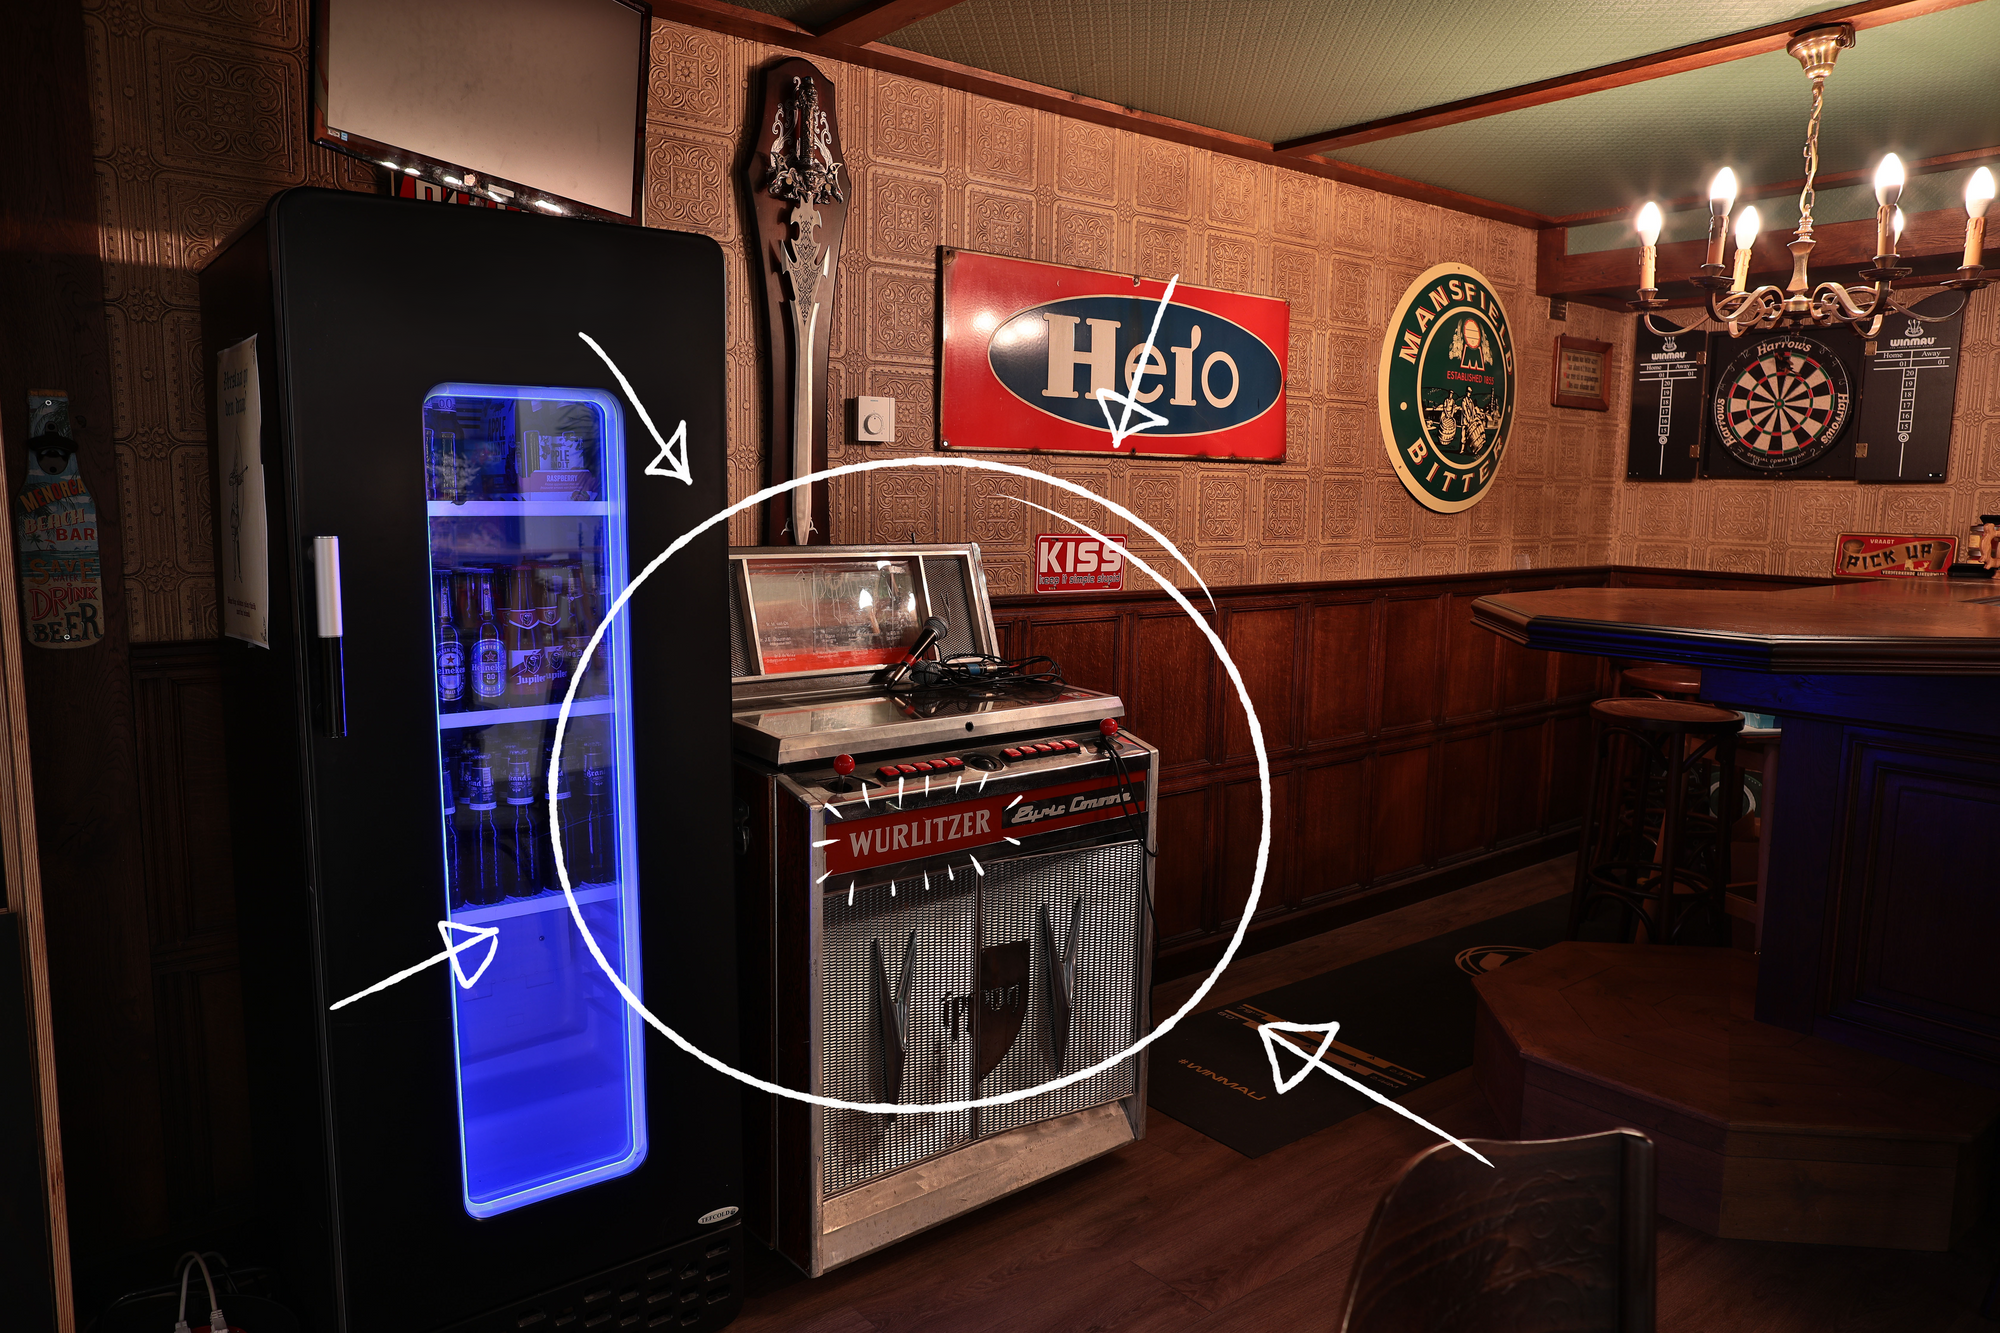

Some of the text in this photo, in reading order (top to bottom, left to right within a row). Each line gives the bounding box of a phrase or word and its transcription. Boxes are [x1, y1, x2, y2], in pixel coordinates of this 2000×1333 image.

[1398, 279, 1513, 375] MANSFIELD
[1756, 341, 1812, 357] Harrows
[1890, 336, 1937, 347] WINMAU
[1042, 313, 1240, 410] Heio
[1651, 351, 1687, 361] WINMAU
[1883, 350, 1941, 359] Home Away
[1446, 370, 1483, 384] ESTABLISHED
[1716, 398, 1738, 447] Harrows
[1820, 393, 1849, 445] Harrows
[1406, 435, 1503, 493] BITTER
[546, 474, 578, 482] RASPBERRY
[20, 477, 87, 514] MENORCA
[24, 508, 86, 535] BEACH
[56, 528, 96, 541] BAR
[1039, 541, 1124, 573] KISS
[1846, 543, 1934, 570] PICK UP
[29, 558, 98, 586] SAVE
[51, 574, 79, 583] WATER
[1039, 572, 1121, 586] keep it simple stupid
[32, 602, 103, 643] BEER
[437, 666, 466, 675] eineken
[471, 663, 507, 671] Heineken
[545, 669, 568, 681] upiler
[516, 671, 548, 687] Jupiler
[849, 809, 991, 858] WURLITZER
[1178, 1058, 1266, 1101] #WINMAU
[701, 1210, 730, 1223] TEFCOLD
